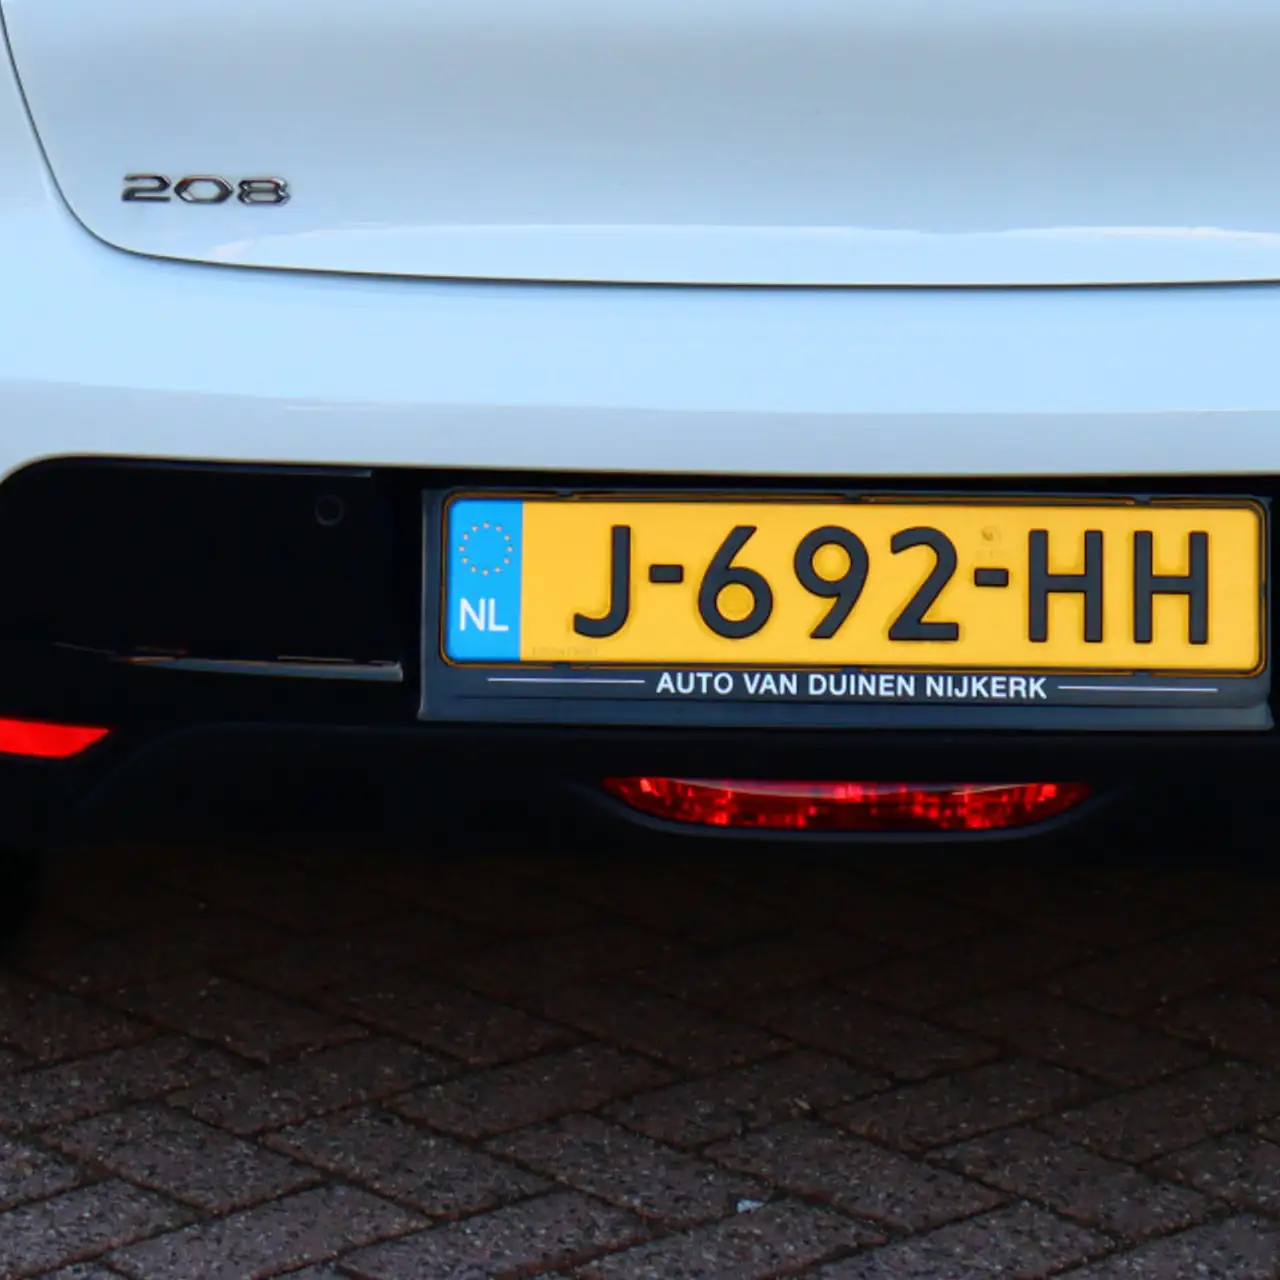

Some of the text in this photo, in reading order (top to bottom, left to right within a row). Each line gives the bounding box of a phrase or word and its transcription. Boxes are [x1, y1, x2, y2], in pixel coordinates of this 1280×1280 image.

[122, 173, 290, 205] 208
[573, 524, 1209, 645] J-692-HH
[459, 598, 509, 632] NL
[656, 672, 1047, 699] AUTO VAN DUINEN NIJKERK
